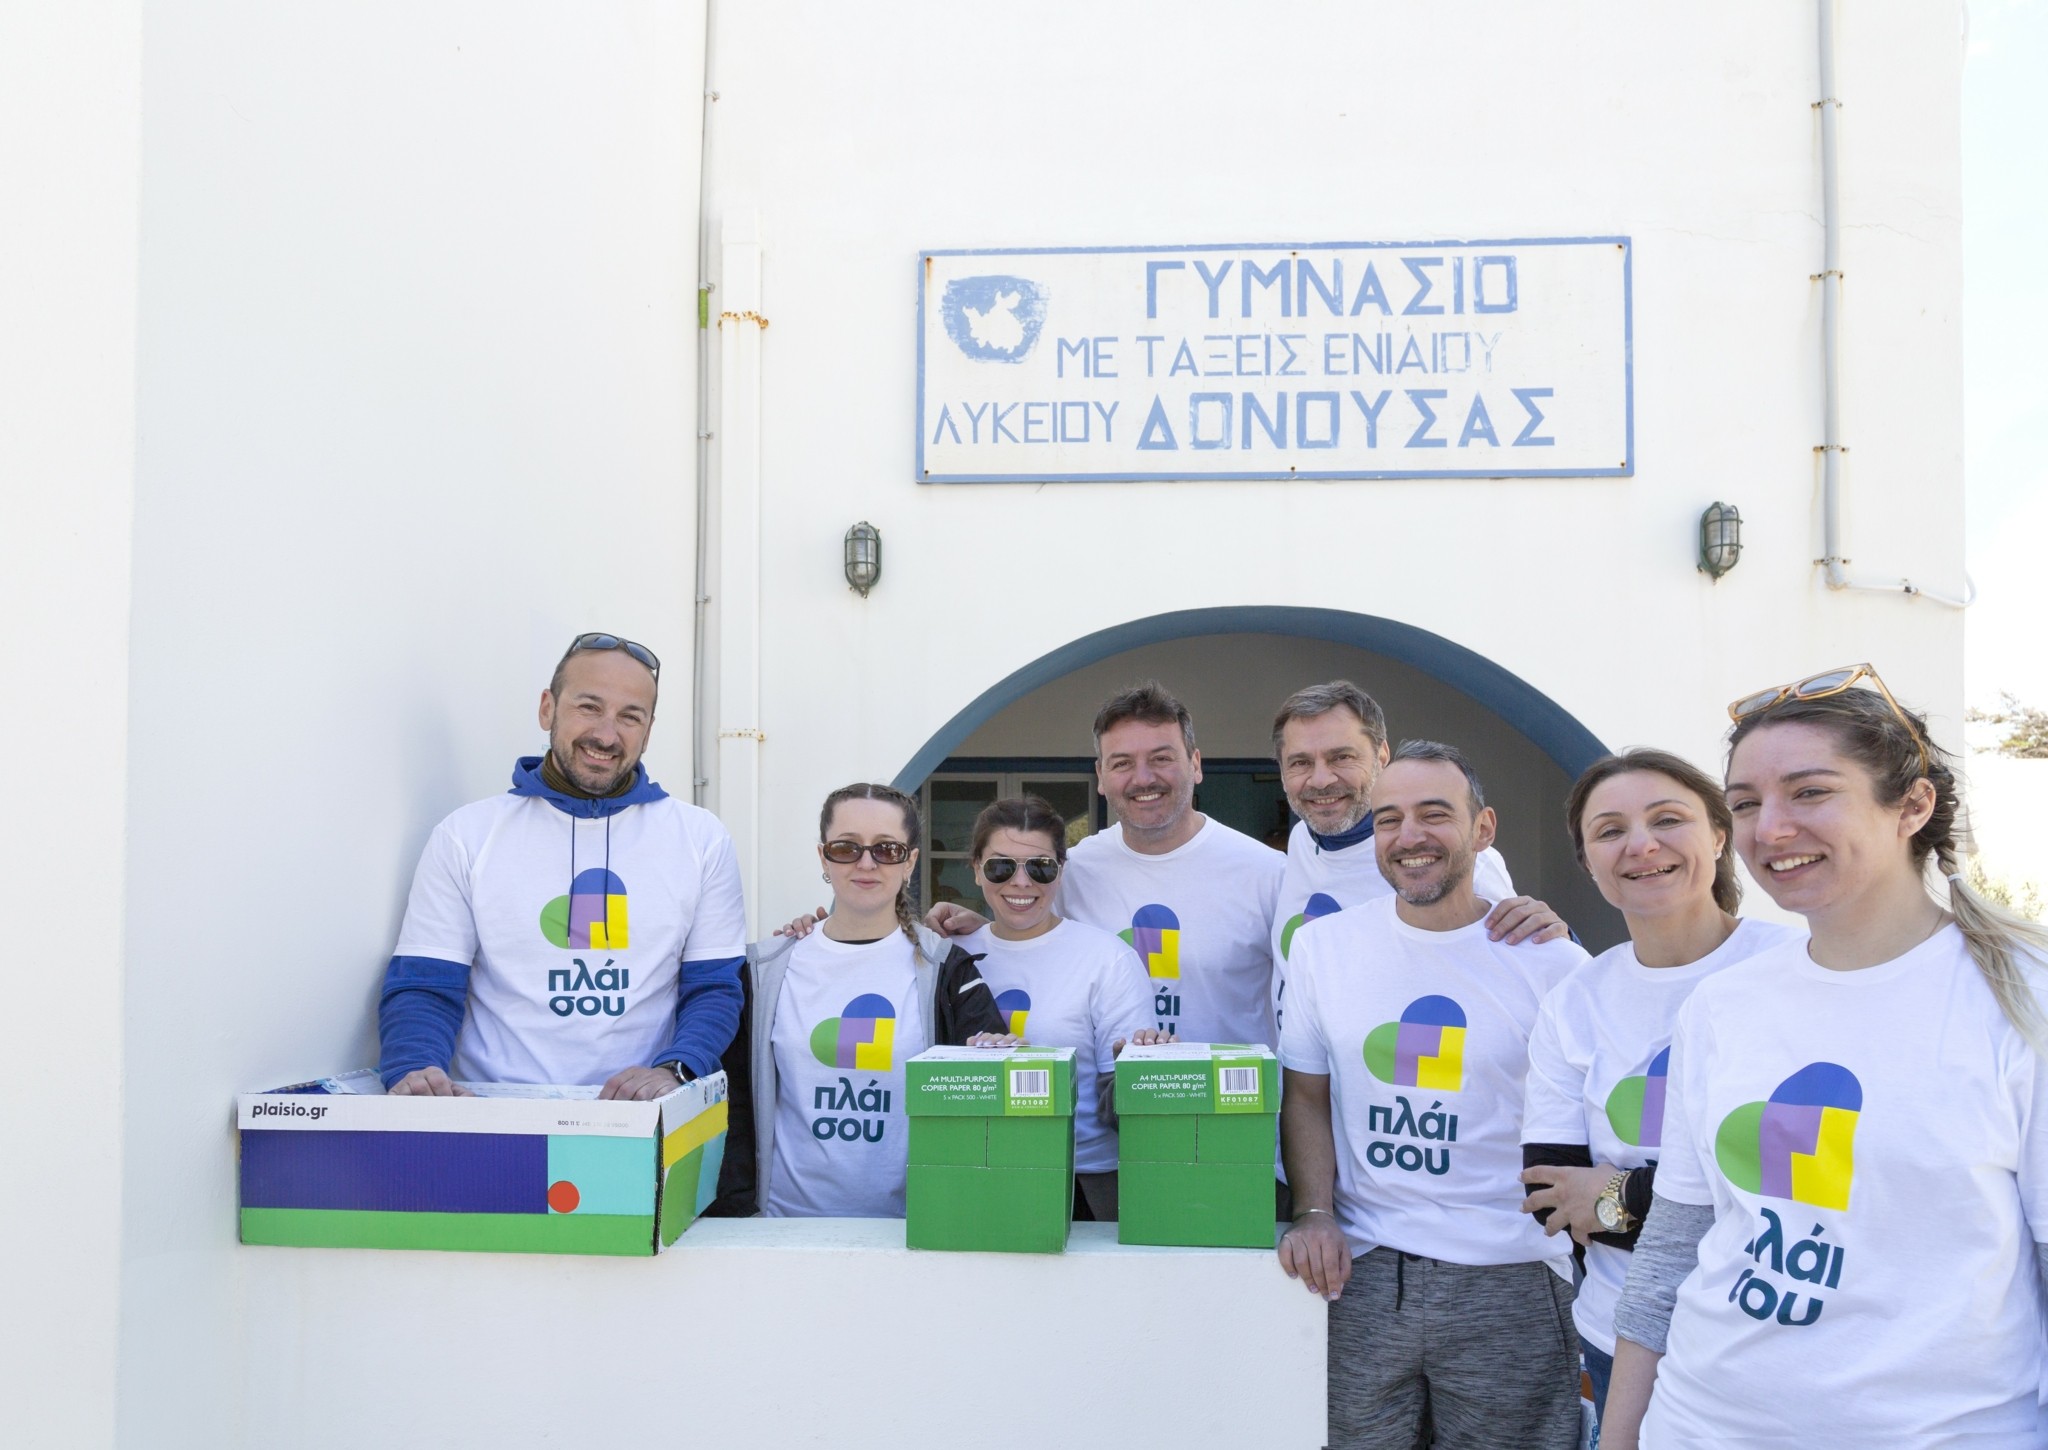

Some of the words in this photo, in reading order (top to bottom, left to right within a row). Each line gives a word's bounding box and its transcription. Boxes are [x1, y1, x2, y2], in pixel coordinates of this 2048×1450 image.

[1146, 254, 1519, 319] ΓΥΜΝΑΣΙΟ
[1057, 336, 1119, 379] ΜΕ
[1136, 333, 1308, 378] ΤΑΞΕΙΣ
[1324, 331, 1503, 377] ΕΝΙΑΙΟΥ
[932, 400, 1120, 445] ΛΥΚΕΙΟΥ
[1136, 388, 1555, 451] ΔΟΝΟΥΣΑΣ
[548, 958, 630, 992] πλάι
[548, 995, 626, 1018] σου
[1154, 985, 1181, 1017] άι
[921, 1084, 948, 1092] COPIER
[949, 1084, 971, 1092] PAPER
[972, 1084, 980, 1092] 80
[929, 1075, 939, 1083] A4
[940, 1075, 997, 1083] MULTI-PURPOSE
[1131, 1082, 1158, 1090] COPIER
[1159, 1082, 1181, 1090] PAPER
[1182, 1082, 1191, 1090] 80
[1139, 1074, 1149, 1082] A4
[1150, 1073, 1207, 1082] MULTI-PURPOSE
[251, 1102, 328, 1120] plaisio.gr
[814, 1076, 891, 1113] πλάι
[812, 1116, 885, 1143] σου
[1368, 1095, 1459, 1142] πλάι
[1366, 1140, 1451, 1176] σου
[1743, 1206, 1846, 1290] λάι
